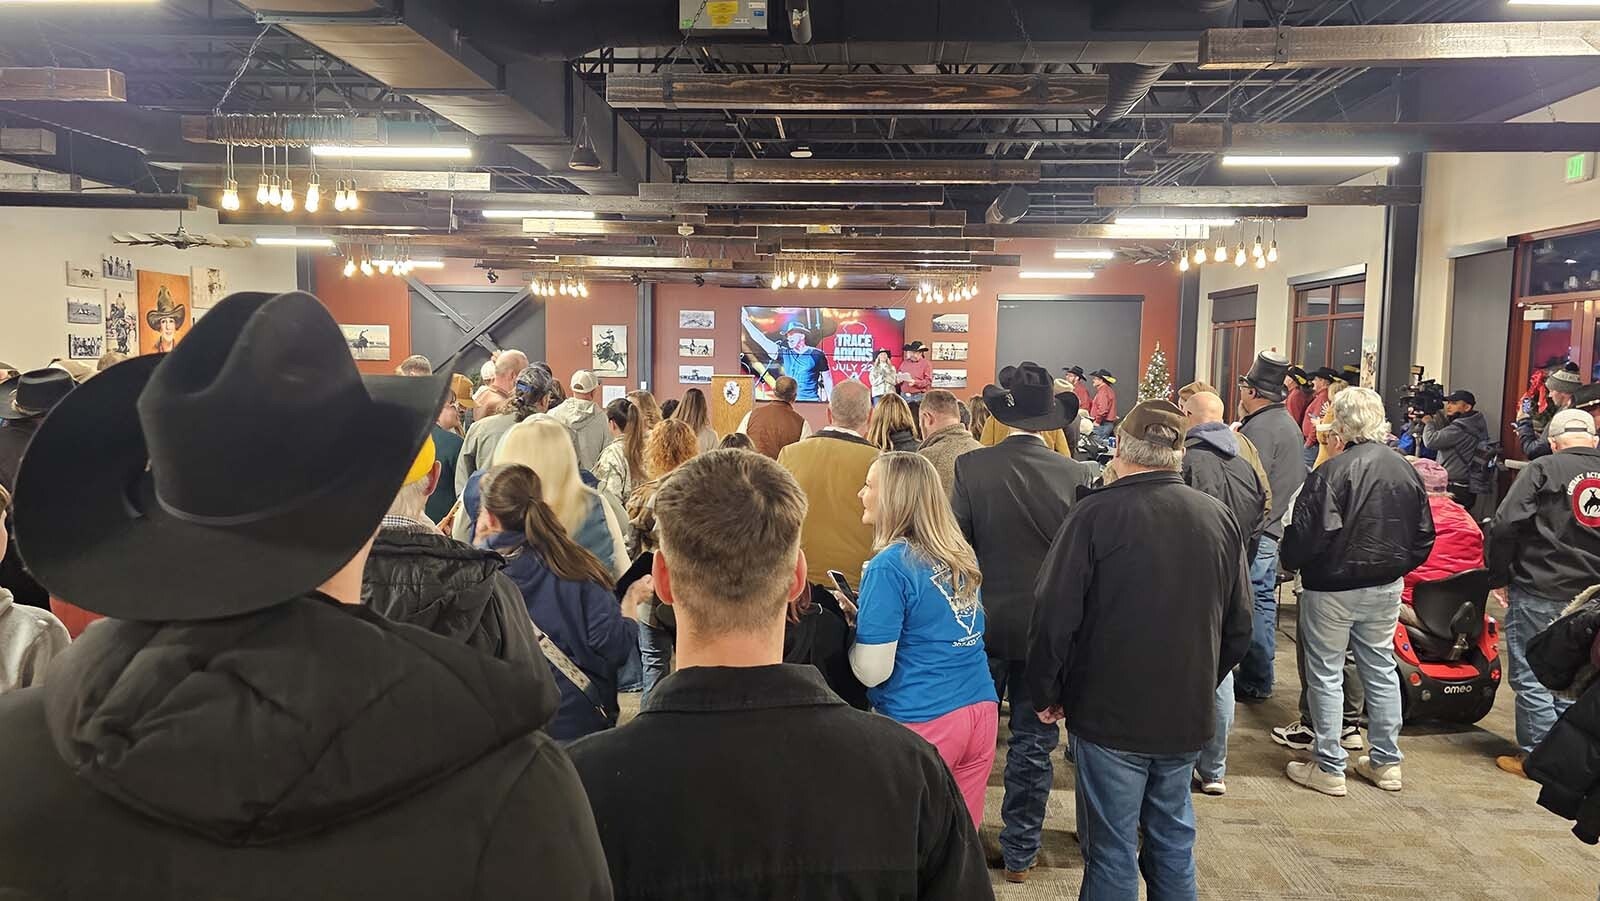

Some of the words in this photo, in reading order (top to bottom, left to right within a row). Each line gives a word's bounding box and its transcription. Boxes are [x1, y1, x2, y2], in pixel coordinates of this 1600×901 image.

[836, 334, 873, 347] TRACE
[833, 347, 873, 361] ADKINS
[832, 363, 858, 372] JULY
[860, 363, 874, 372] 22
[1443, 684, 1473, 694] omeo
